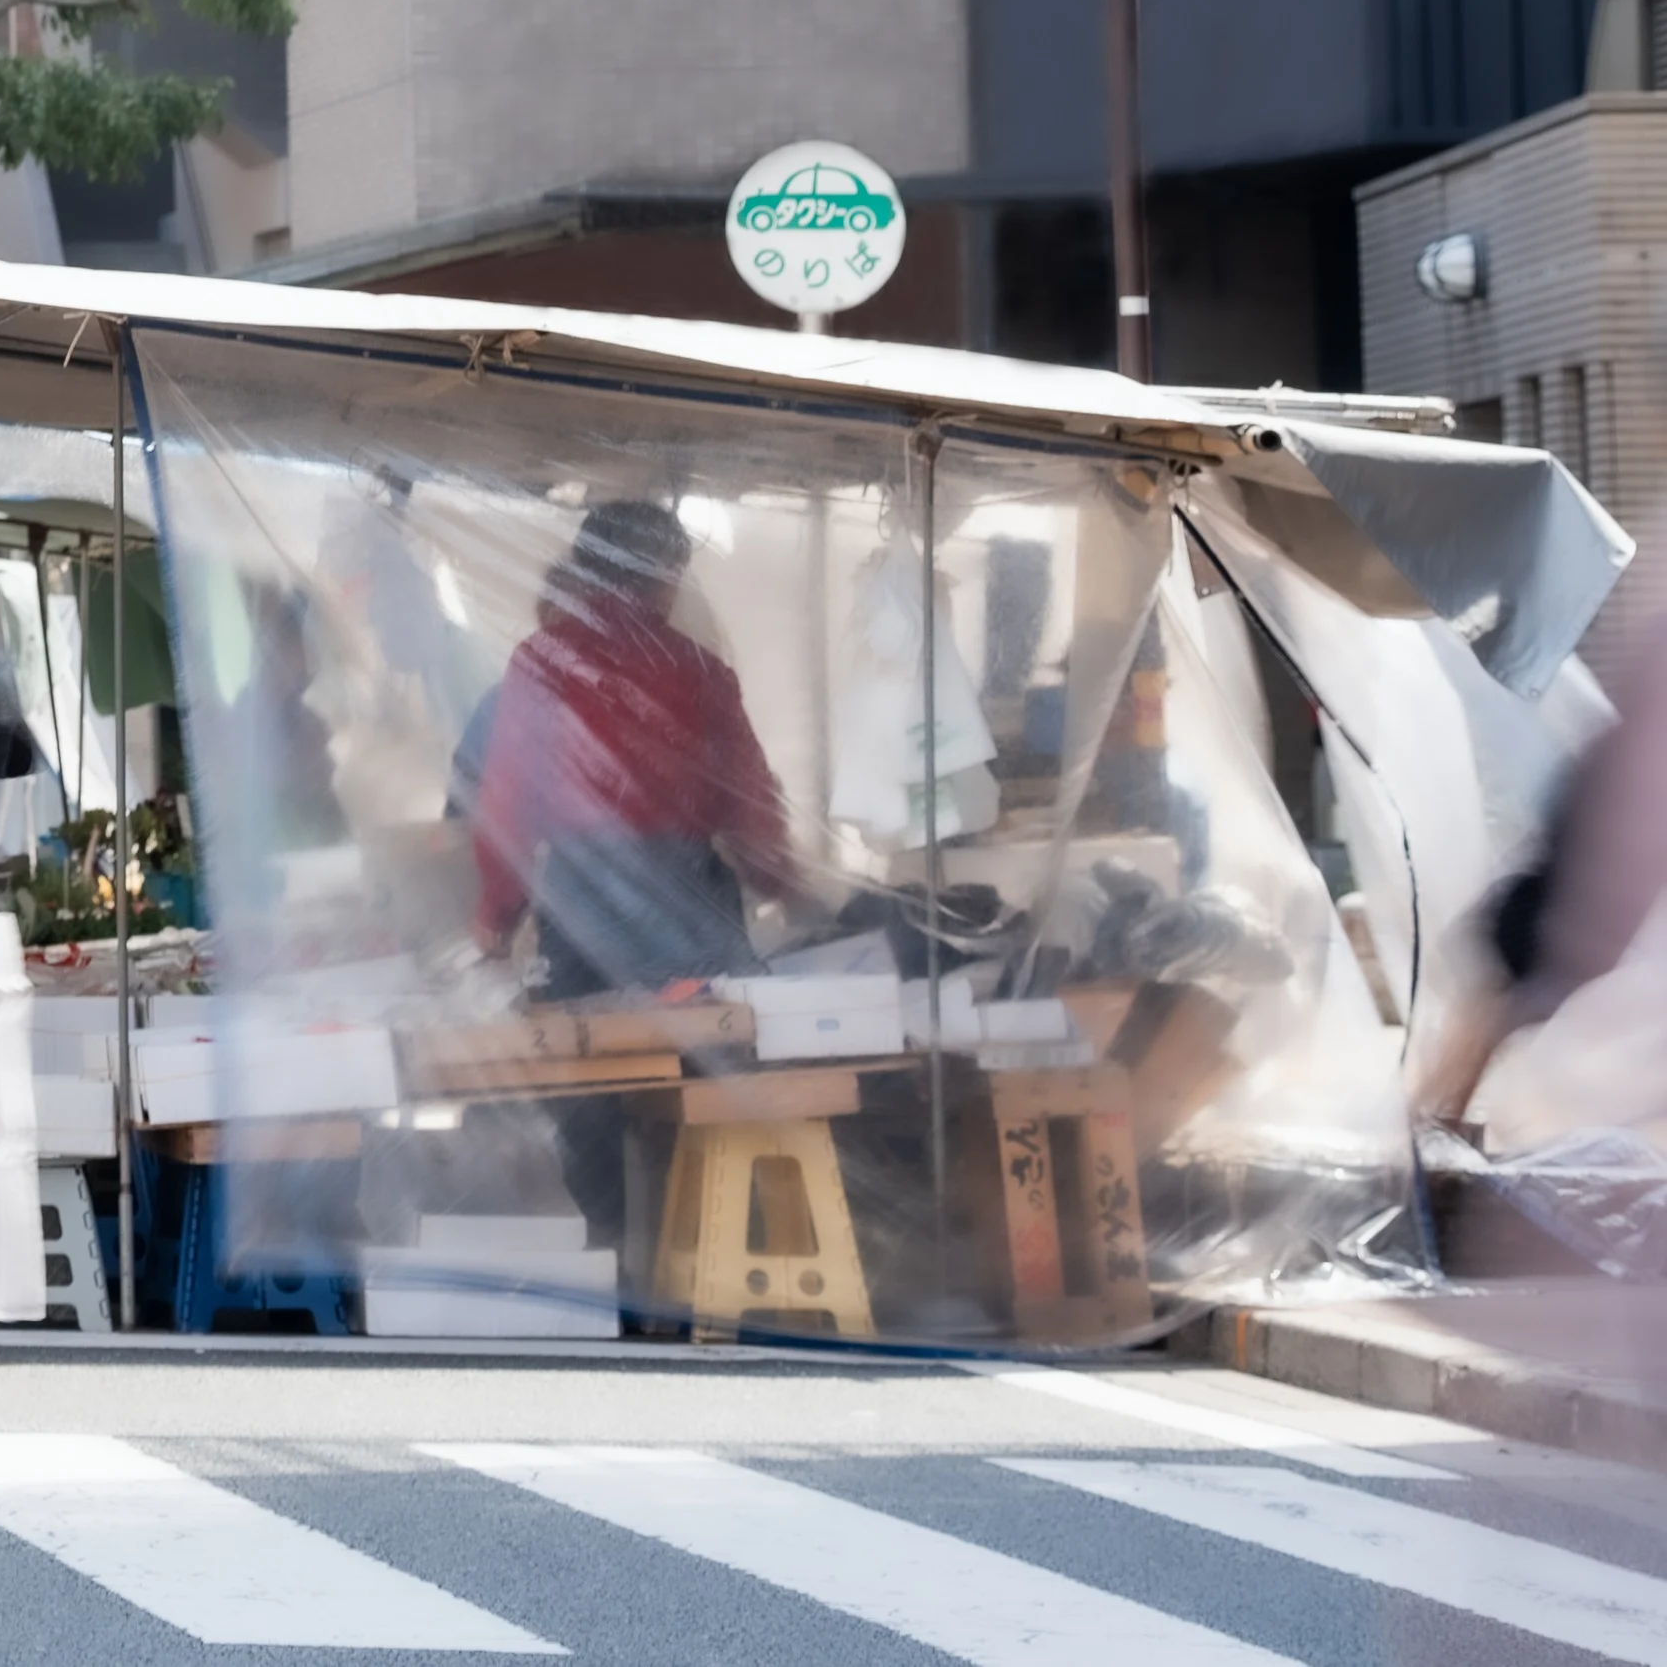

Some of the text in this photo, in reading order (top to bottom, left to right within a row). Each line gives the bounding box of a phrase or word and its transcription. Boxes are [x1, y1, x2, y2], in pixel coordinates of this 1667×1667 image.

[775, 198, 847, 227] タクシー
[753, 240, 881, 289] のりば
